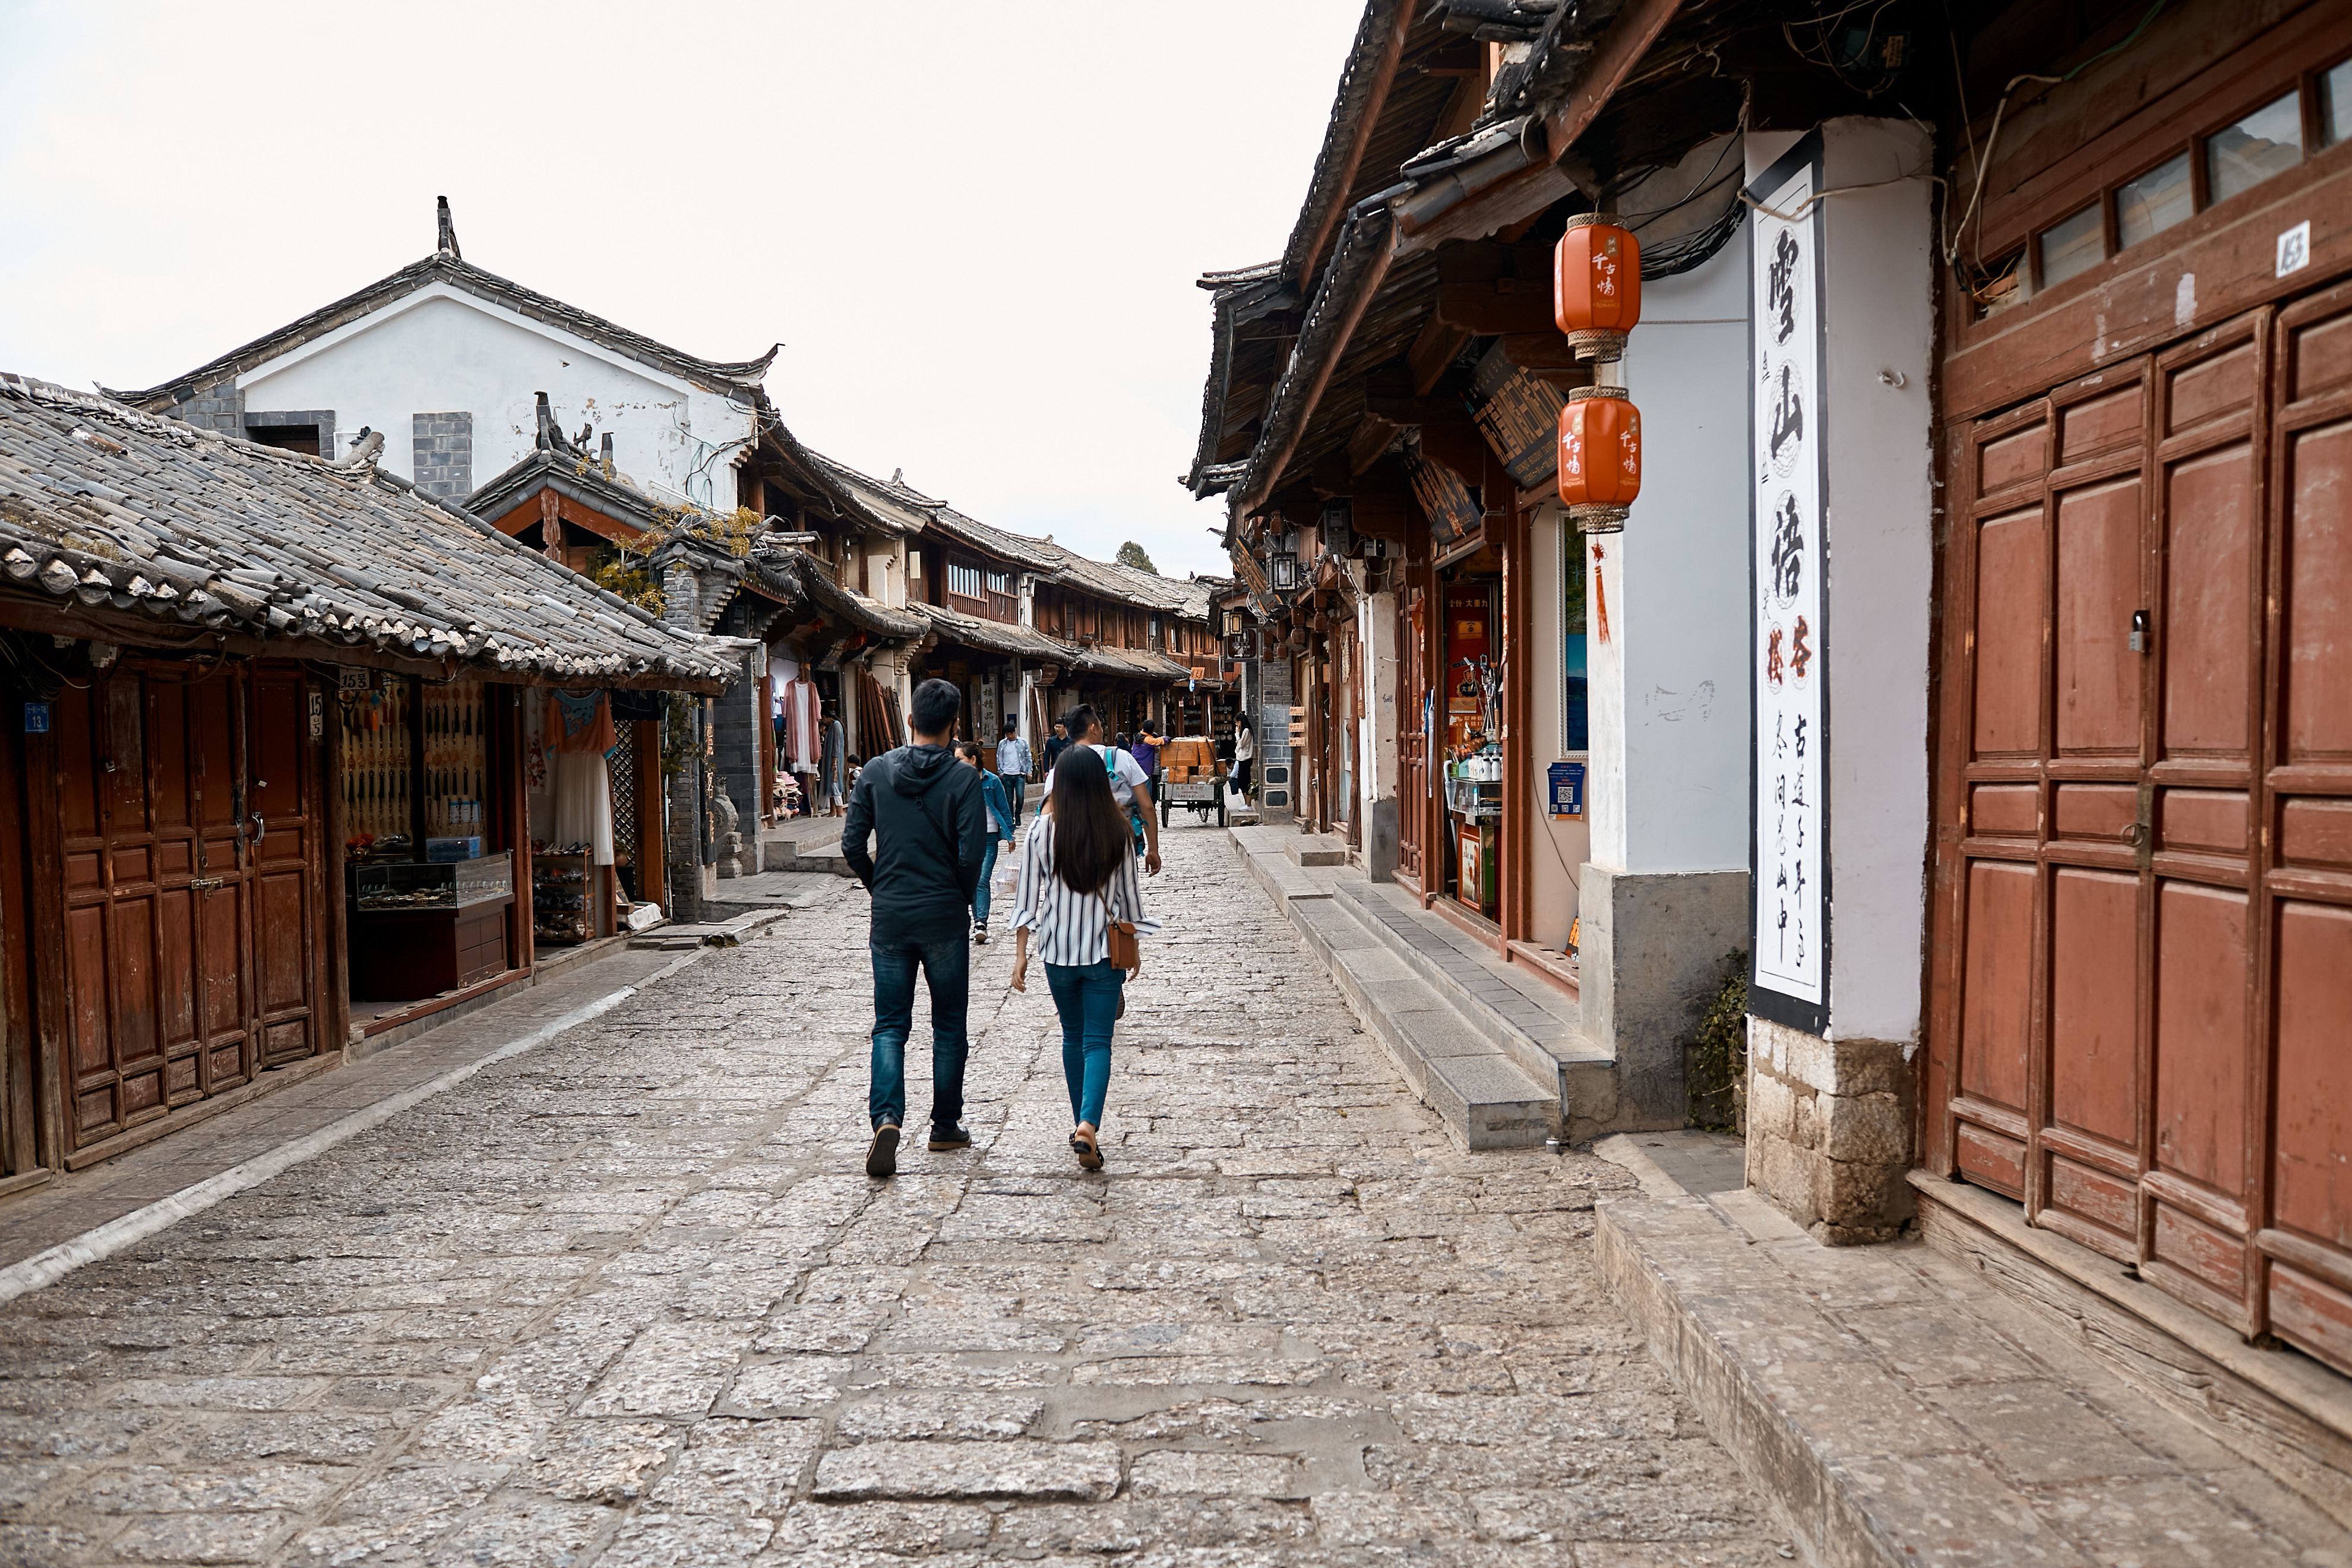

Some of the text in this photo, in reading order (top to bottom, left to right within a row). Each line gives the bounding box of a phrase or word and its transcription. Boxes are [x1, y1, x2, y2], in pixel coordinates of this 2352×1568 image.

[1592, 252, 1616, 296] 千古情
[1562, 431, 1581, 475] 千古情
[1620, 430, 1637, 474] 千古情
[1465, 599, 1488, 608] 大重九
[32, 716, 42, 728] 13
